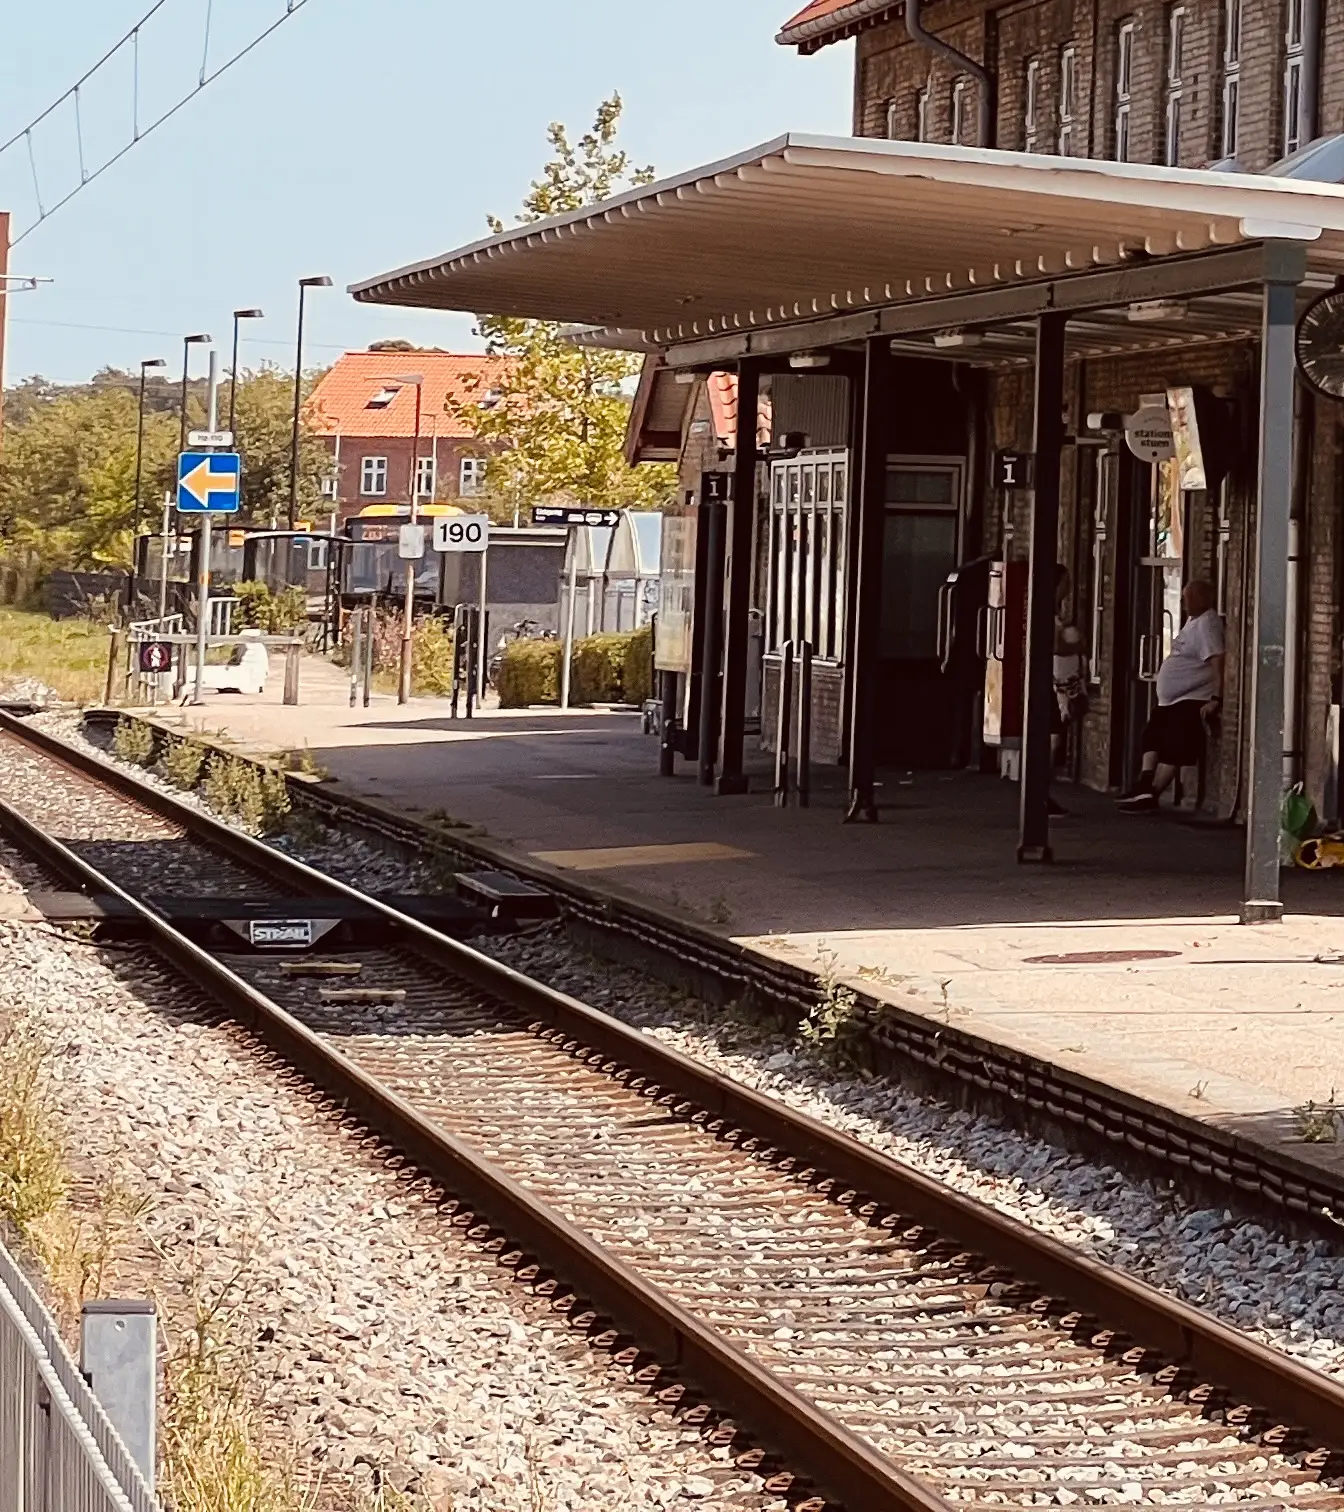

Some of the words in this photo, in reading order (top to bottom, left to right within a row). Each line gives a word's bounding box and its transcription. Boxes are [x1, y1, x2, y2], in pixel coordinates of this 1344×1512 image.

[1134, 430, 1173, 438] station
[1003, 463, 1016, 483] 1
[440, 523, 481, 542] 190
